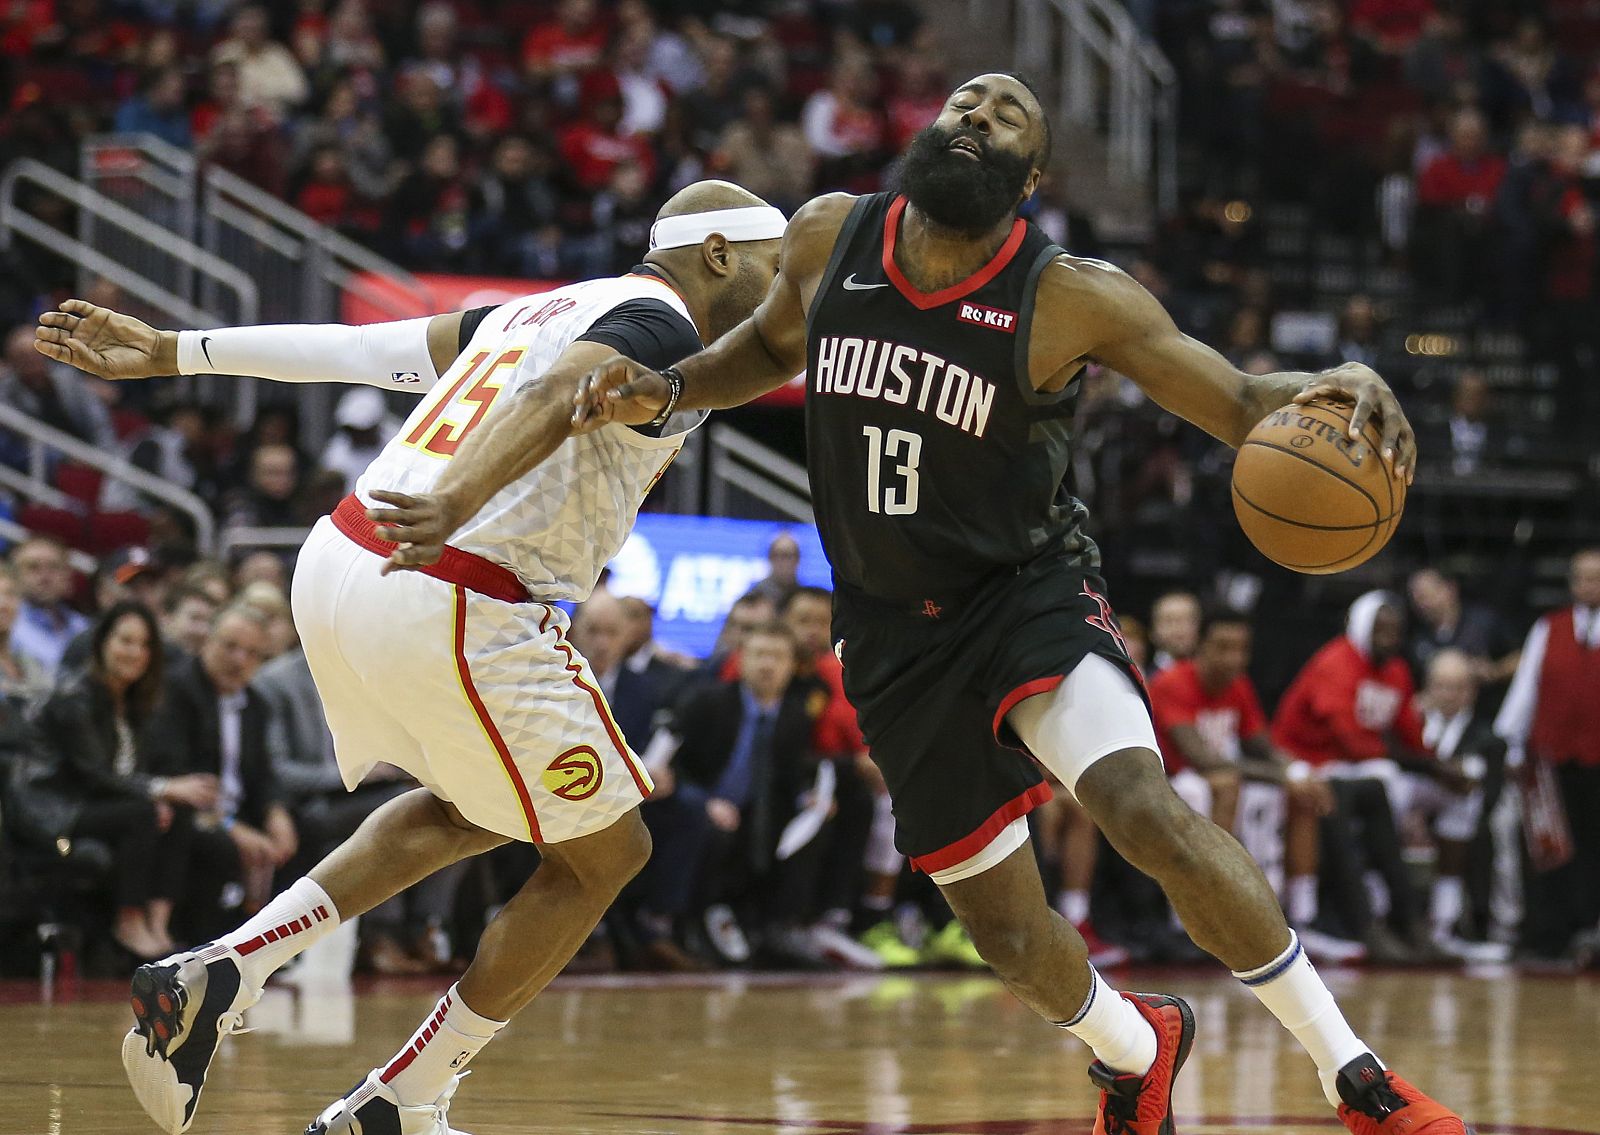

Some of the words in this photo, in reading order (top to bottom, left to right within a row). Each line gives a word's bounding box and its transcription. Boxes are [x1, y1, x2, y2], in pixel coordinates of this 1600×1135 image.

[402, 347, 529, 460] 15
[815, 337, 997, 438] HOUSTON
[862, 425, 923, 516] 13
